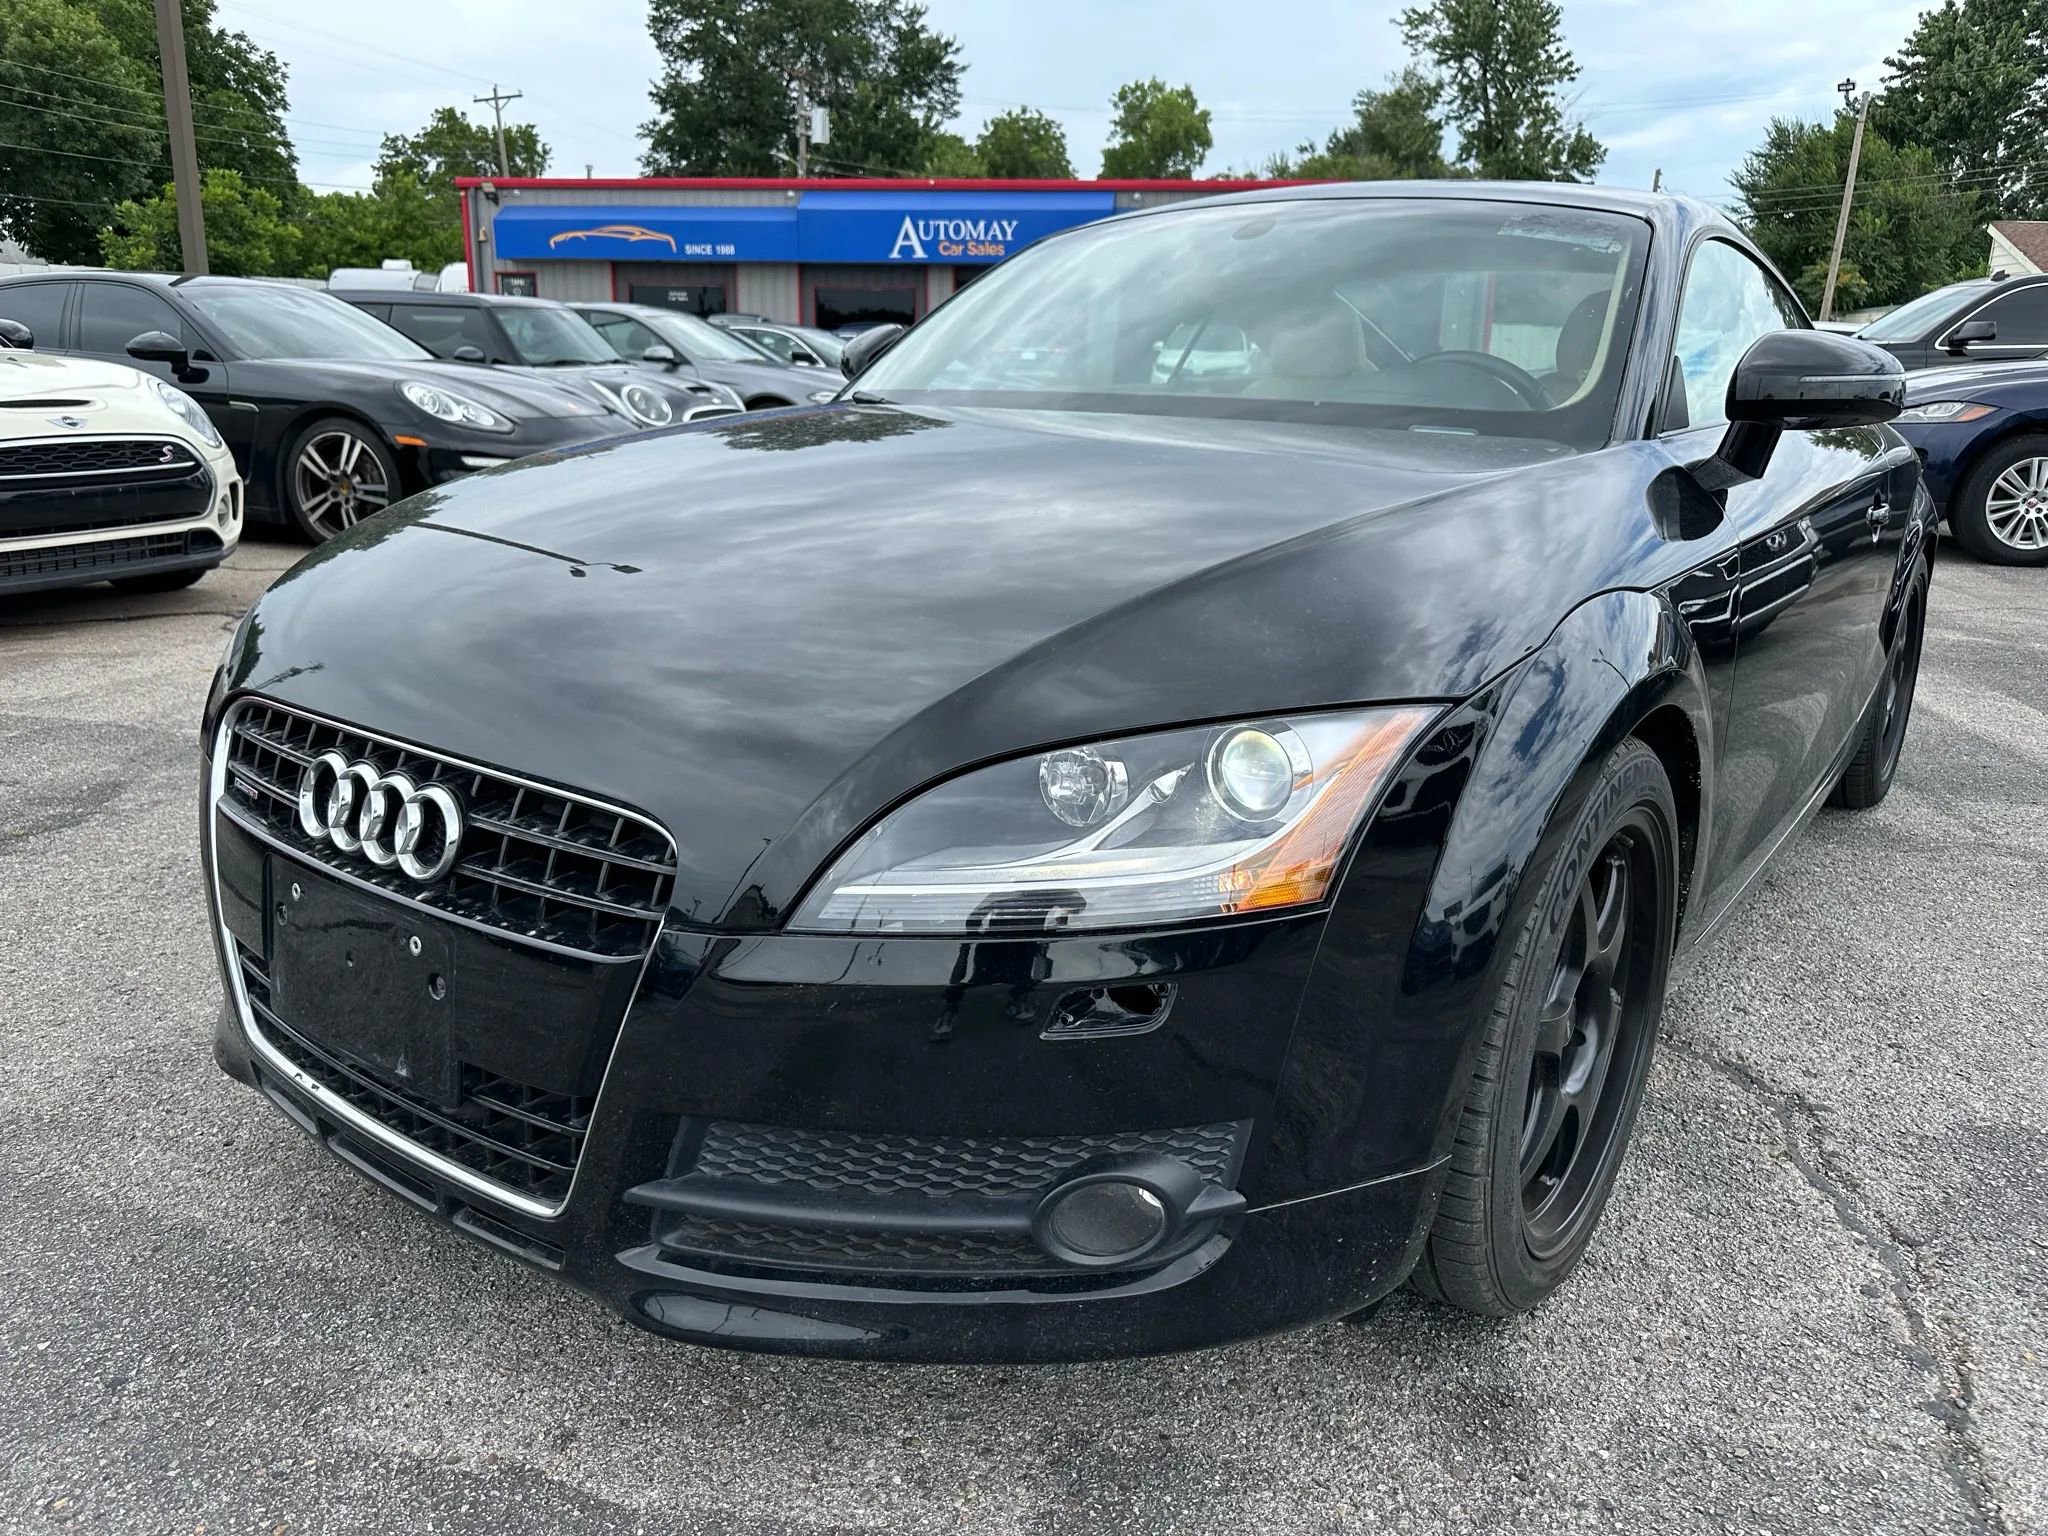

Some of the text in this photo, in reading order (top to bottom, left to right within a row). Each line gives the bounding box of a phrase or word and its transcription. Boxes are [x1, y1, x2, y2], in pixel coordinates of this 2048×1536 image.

[888, 214, 1019, 258] AUTOMAY
[684, 243, 713, 256] SINCE
[938, 241, 1005, 256] Car Sales
[160, 444, 173, 463] S
